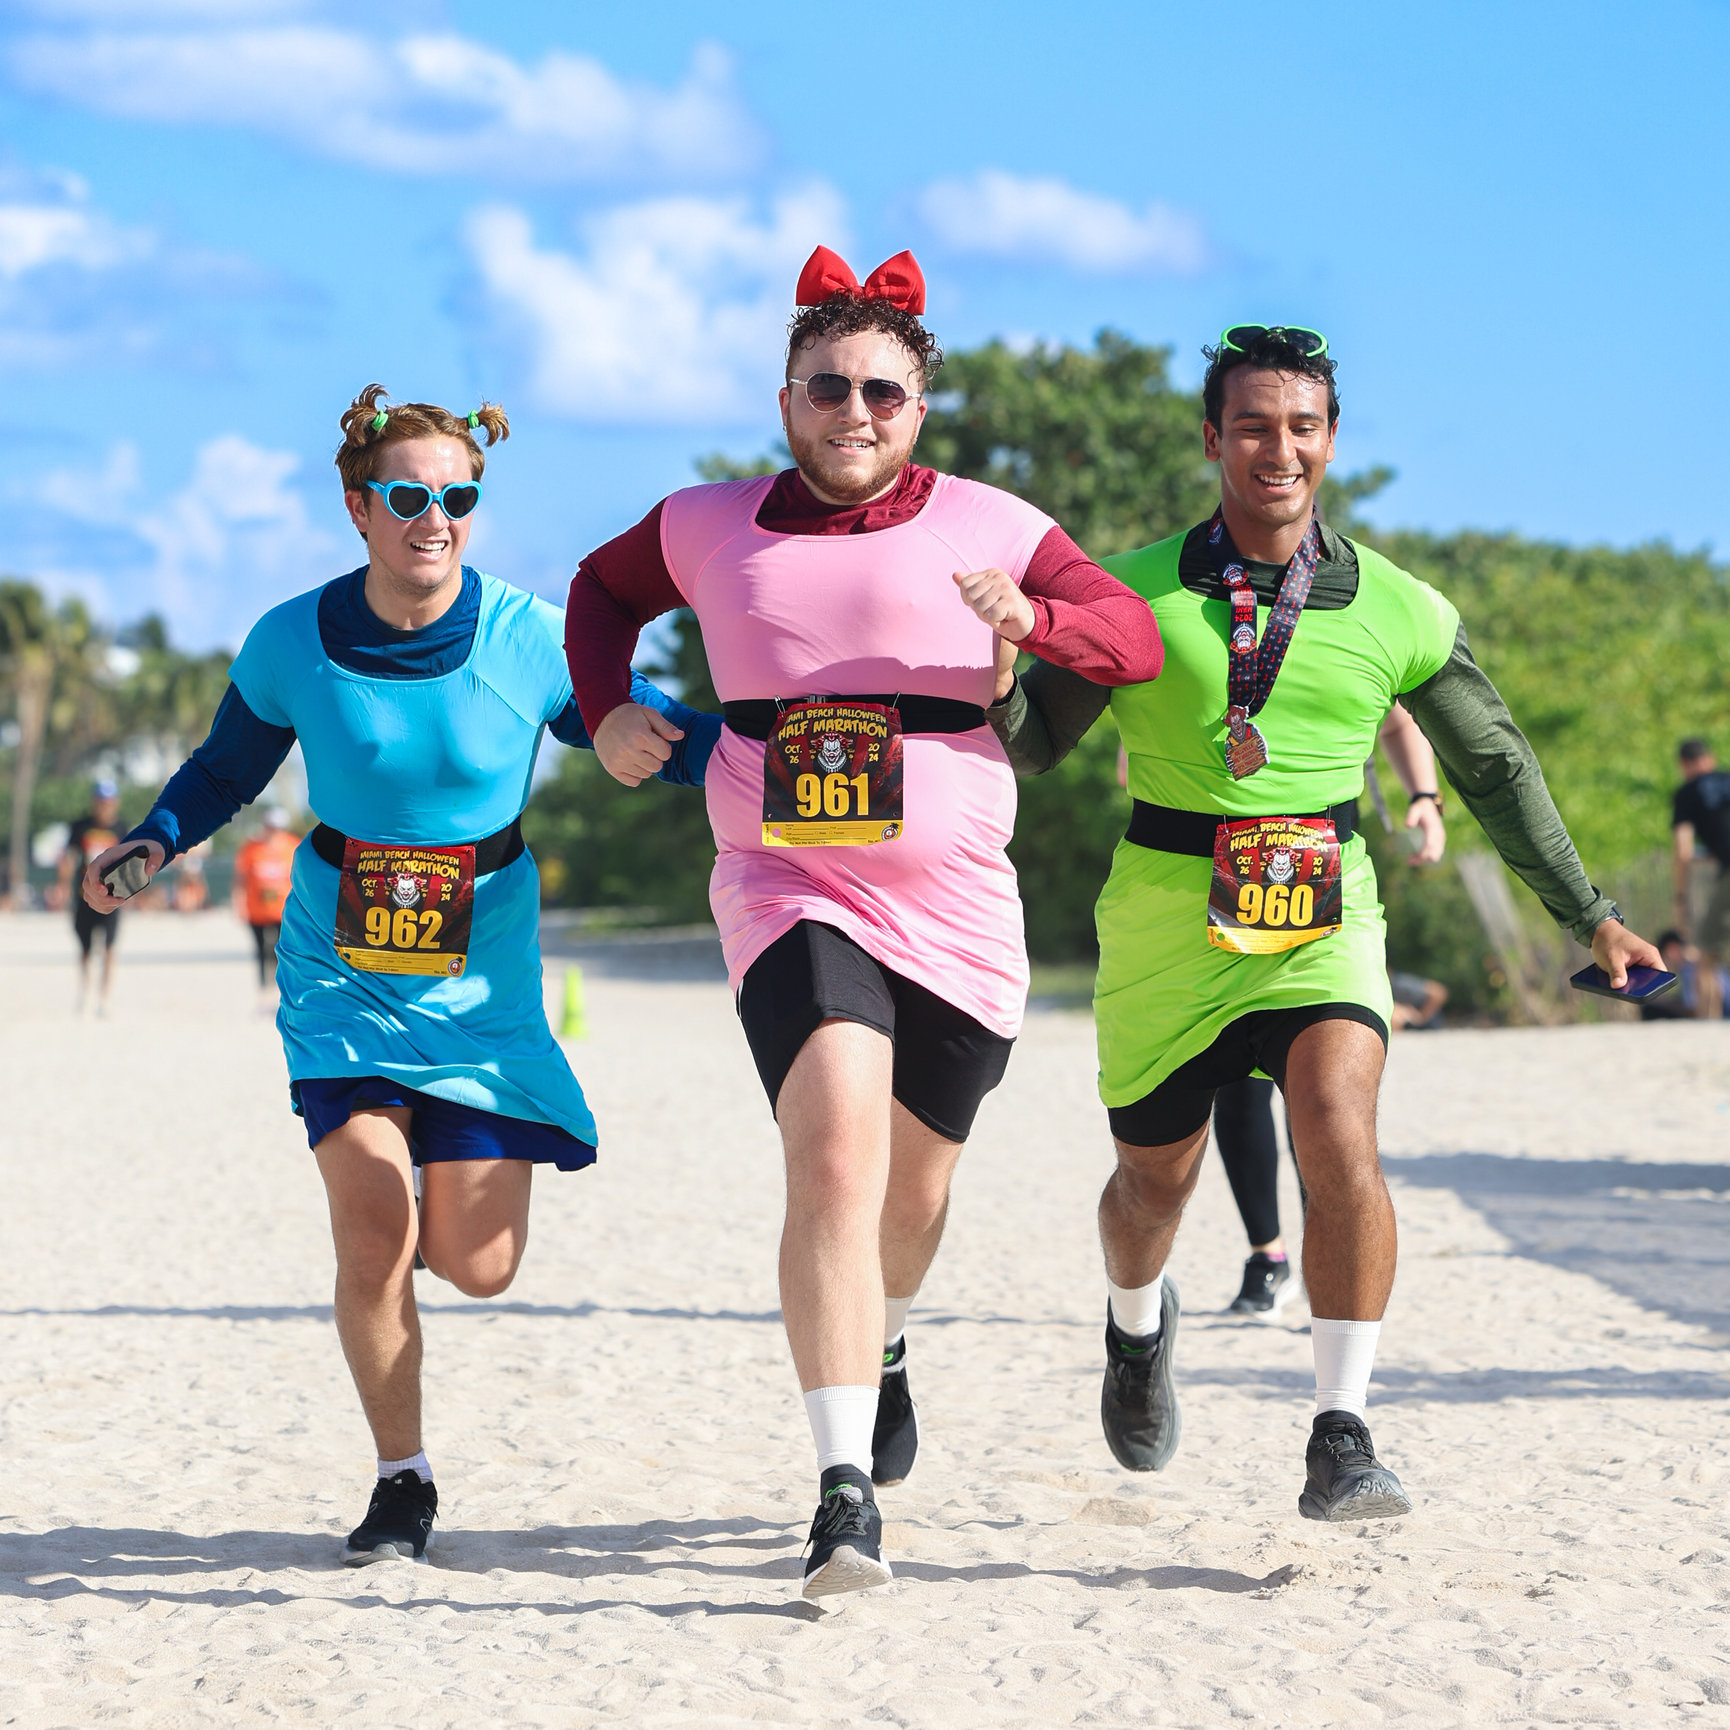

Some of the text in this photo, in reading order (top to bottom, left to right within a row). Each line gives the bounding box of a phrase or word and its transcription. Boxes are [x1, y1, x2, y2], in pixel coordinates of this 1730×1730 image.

[785, 708, 886, 723] AMI BEACH HALLOWEEN
[778, 718, 888, 741] HALF MARATHON
[784, 744, 802, 754] OCT.
[868, 743, 880, 752] 20
[789, 755, 800, 764] 26
[868, 754, 879, 762] 24
[796, 773, 869, 818] 961
[1260, 822, 1286, 832] BEACH
[1230, 833, 1262, 852] HALF
[360, 850, 460, 866] MIAMI BEACH HALLOWEEN
[1236, 856, 1254, 865] OCT.
[1312, 856, 1323, 866] 20
[357, 860, 460, 880] HALF MARATHON
[1240, 866, 1250, 875] 26
[1312, 867, 1322, 876] 24
[362, 878, 378, 888] OCT.
[440, 883, 452, 892] 20
[365, 888, 375, 898] 26
[440, 893, 451, 901] 24
[1236, 883, 1314, 927] 960
[364, 906, 443, 948] 962
